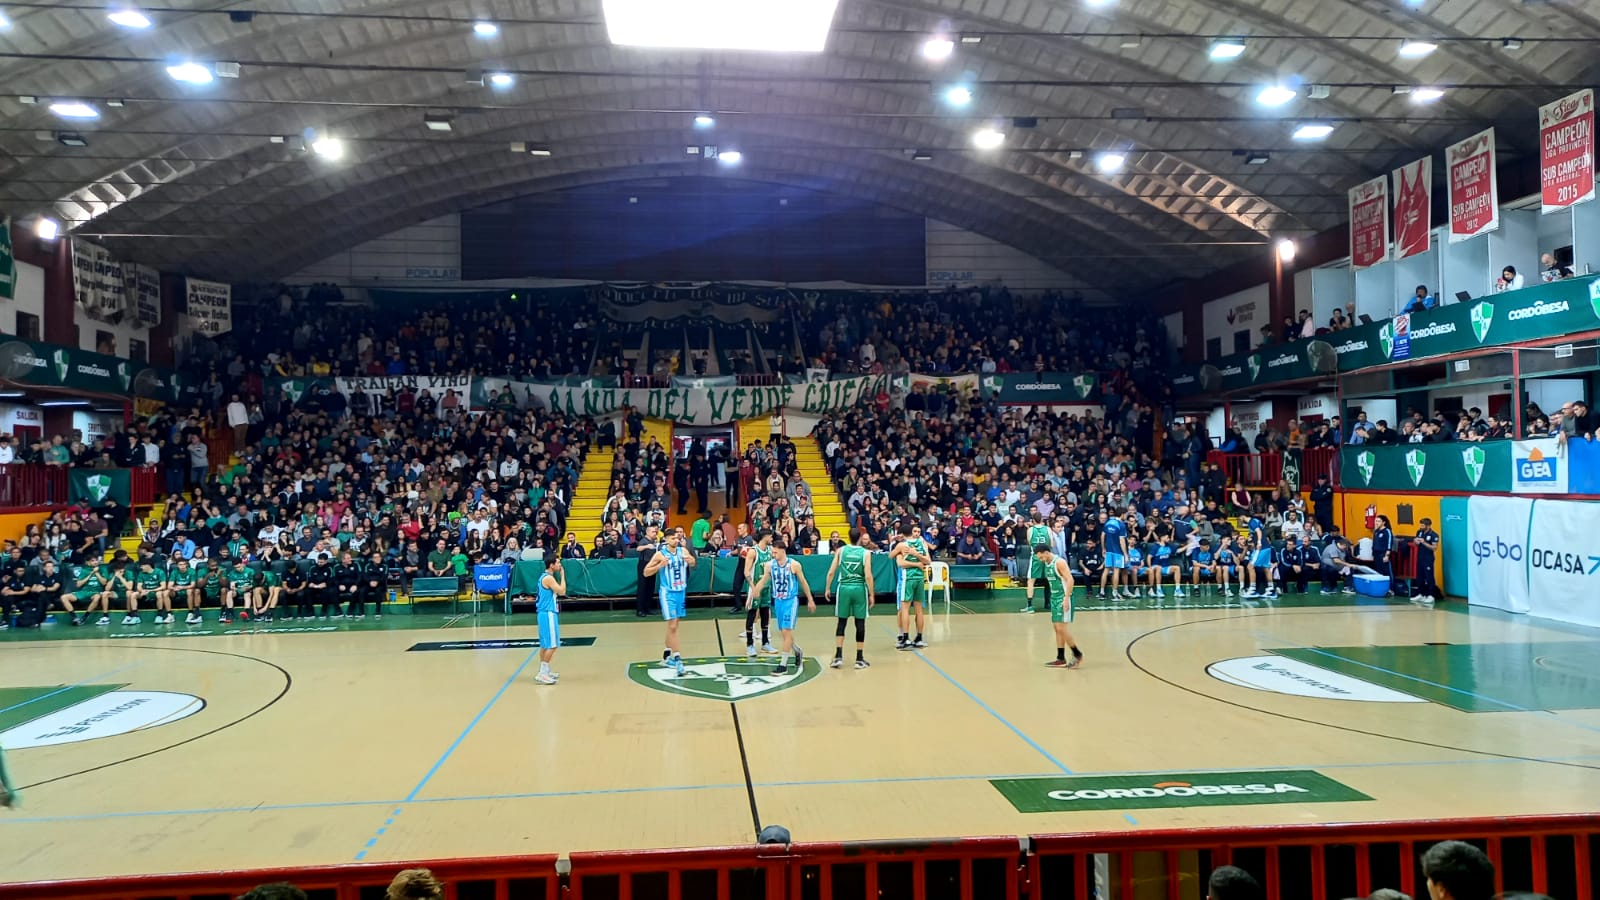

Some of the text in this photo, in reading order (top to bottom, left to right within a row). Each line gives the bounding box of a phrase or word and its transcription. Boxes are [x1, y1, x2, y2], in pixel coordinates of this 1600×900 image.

[1545, 118, 1588, 150] CAMPEÓN
[1543, 165, 1556, 180] SUB
[1558, 184, 1577, 202] 2015
[406, 268, 456, 279] POPULAR
[1508, 301, 1569, 320] CORDOBESA
[647, 387, 698, 423] DEL
[707, 384, 795, 424] VERDE
[1521, 461, 1552, 479] GEA
[844, 561, 860, 570] 77
[1532, 549, 1584, 575] OCASA
[776, 581, 788, 592] 22
[1047, 782, 1309, 801] CORDOBESA
